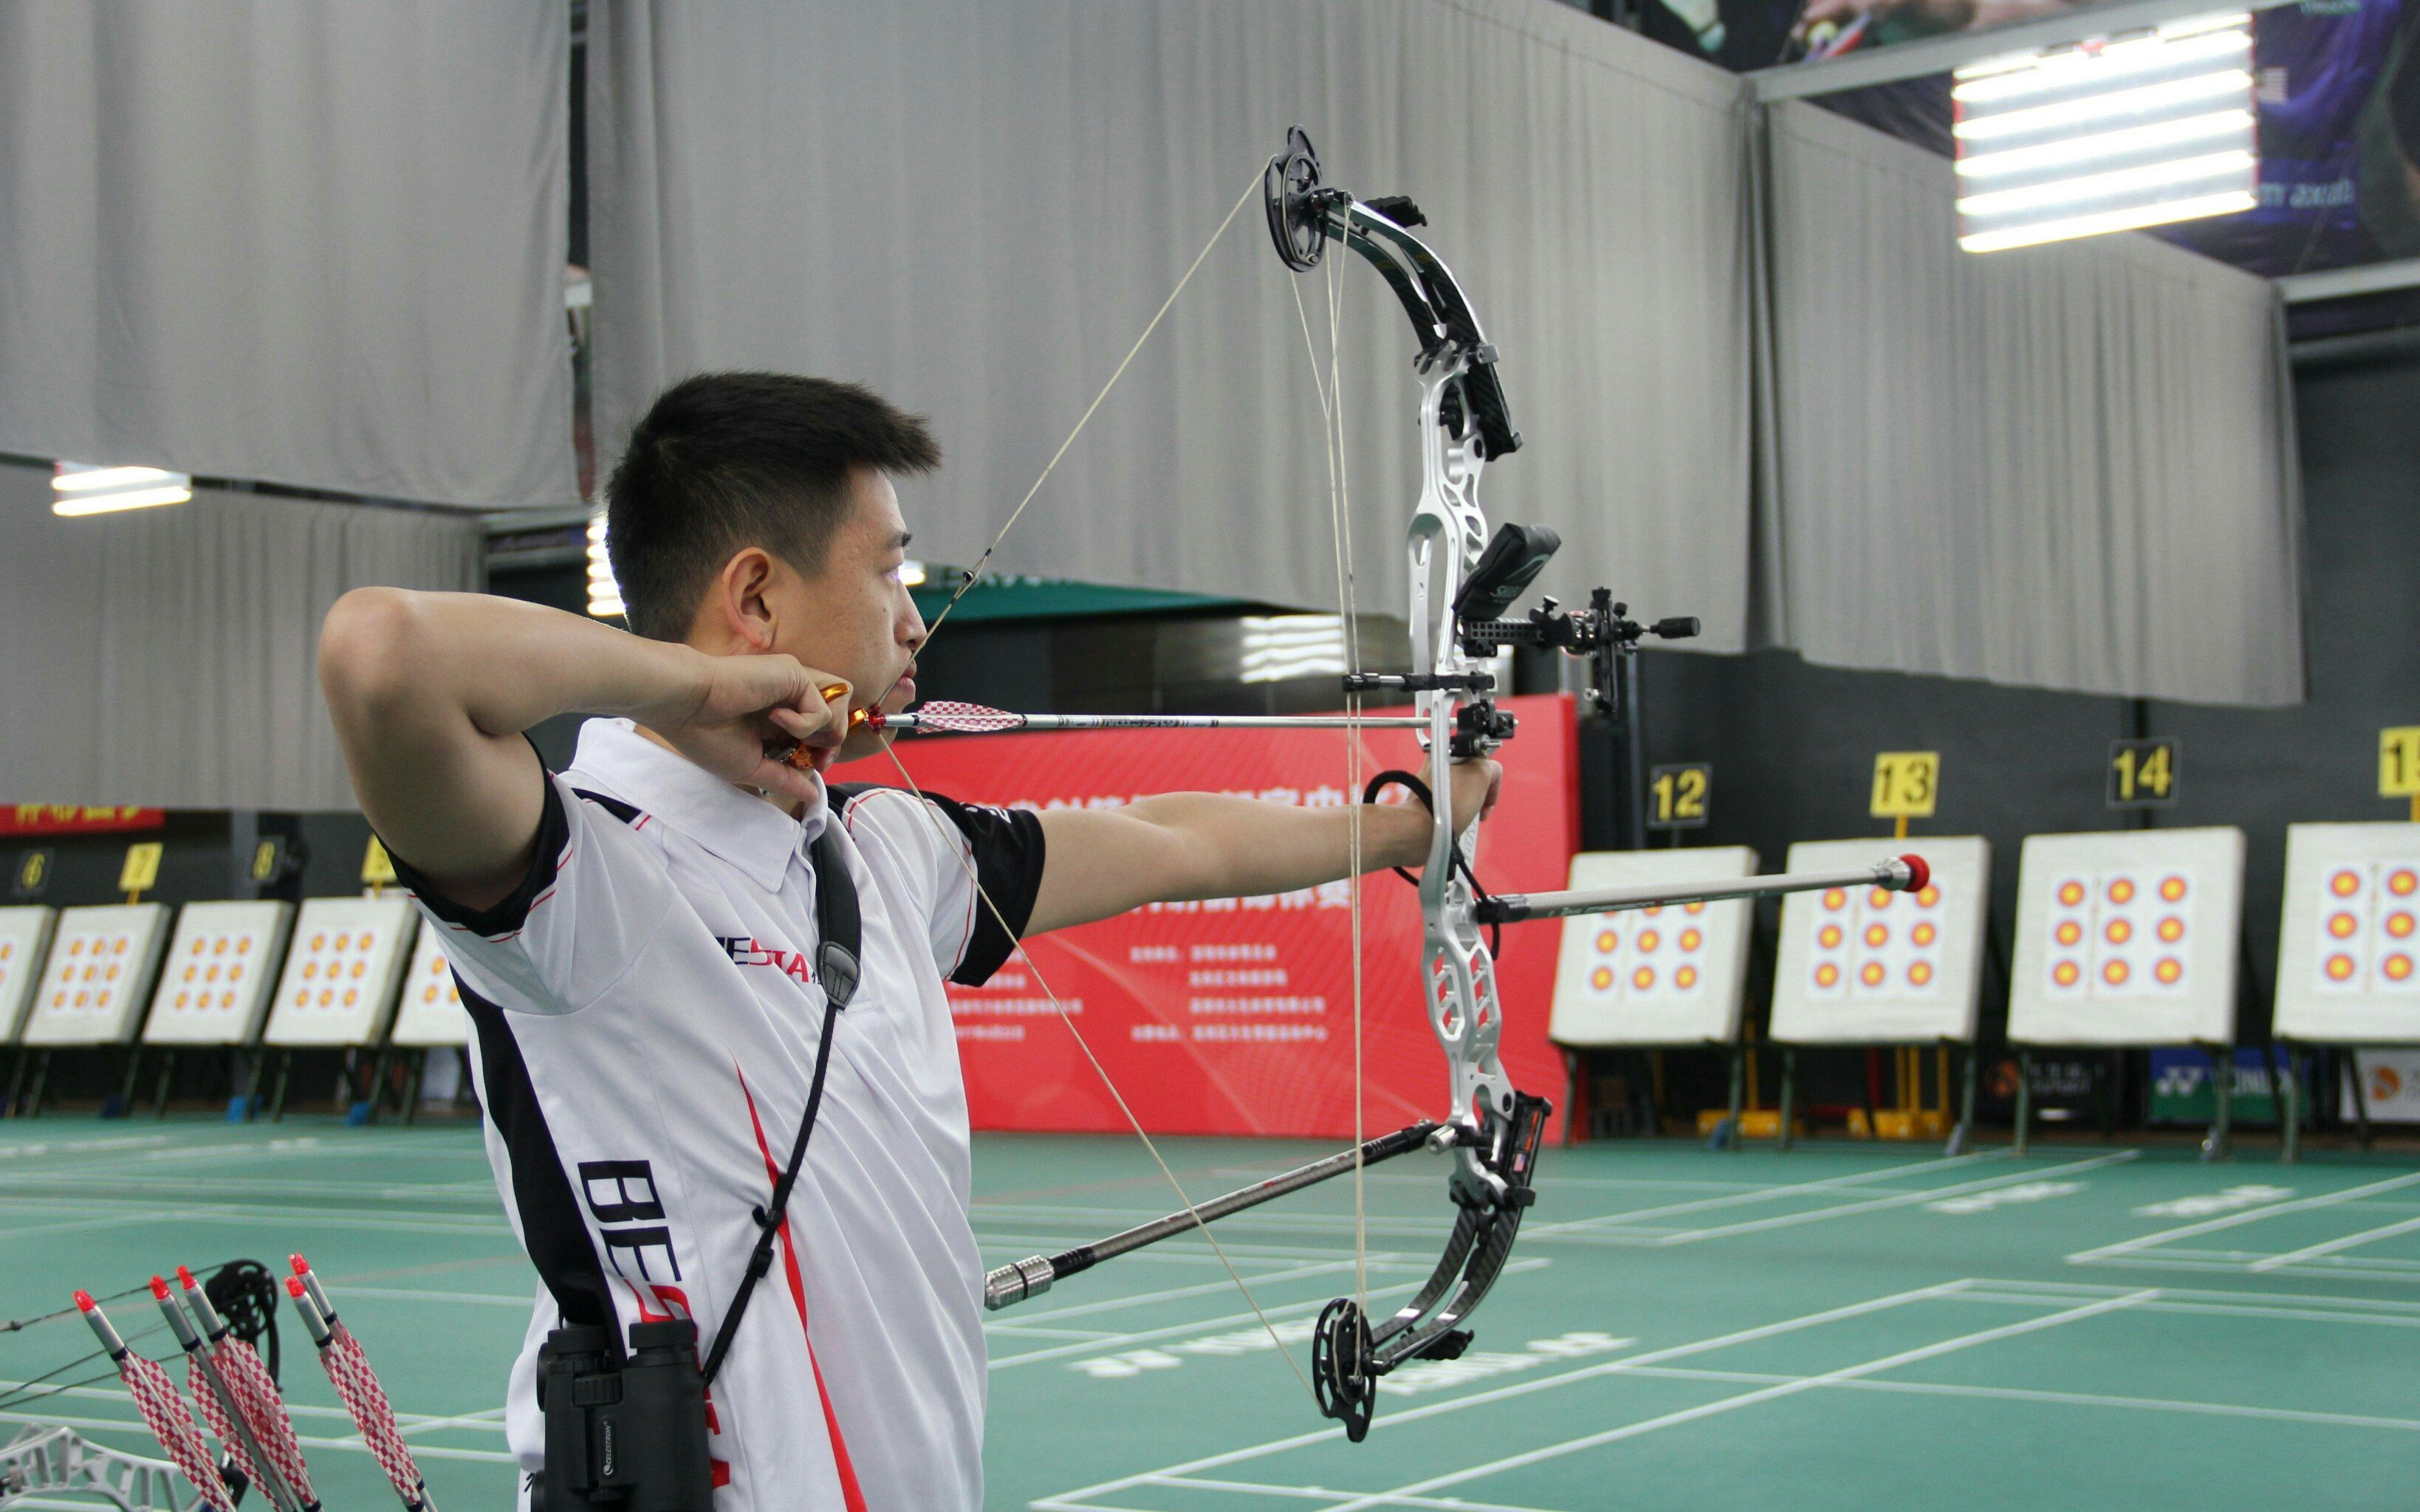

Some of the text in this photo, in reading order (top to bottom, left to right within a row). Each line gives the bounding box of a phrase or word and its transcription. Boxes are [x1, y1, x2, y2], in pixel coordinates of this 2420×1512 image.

[1876, 759, 1931, 807] 13
[2112, 745, 2173, 800] 14
[2384, 740, 2420, 785] 1
[1651, 769, 1707, 822] 12
[21, 852, 46, 890] 6
